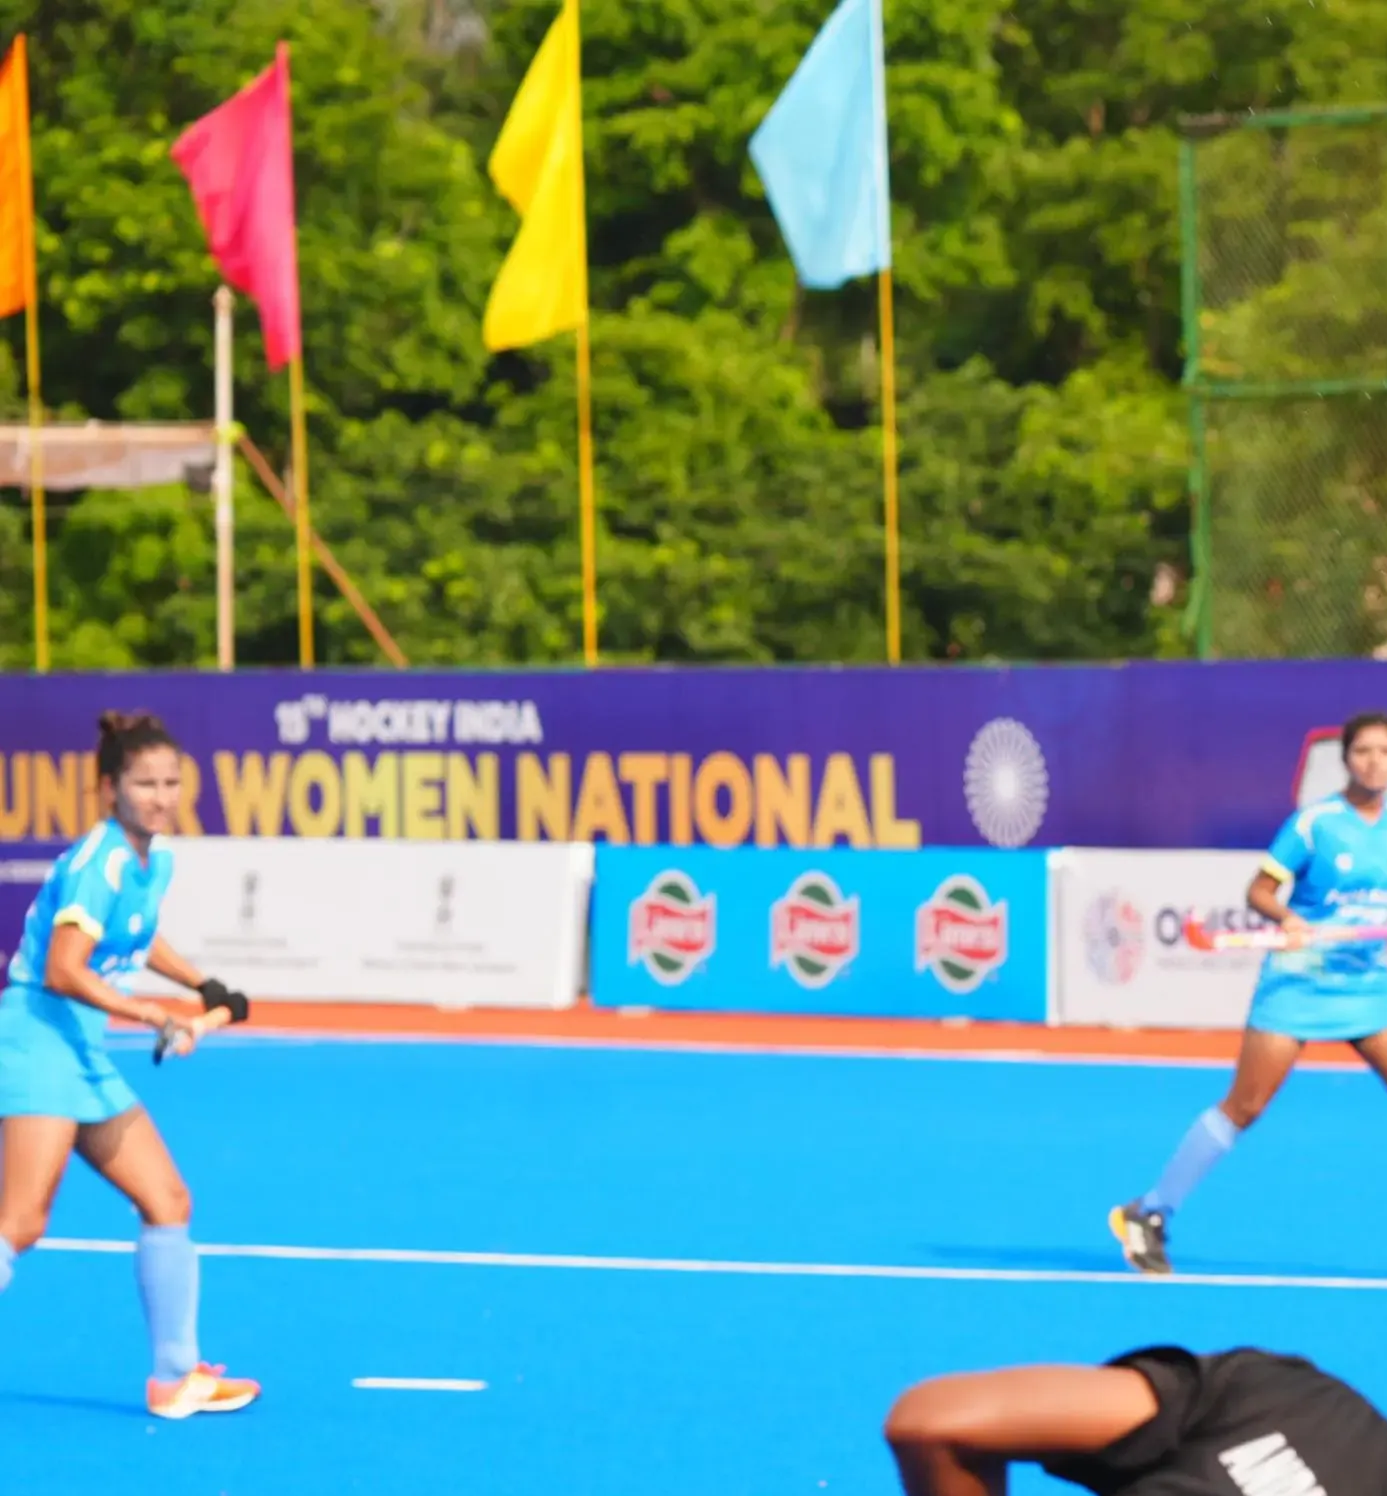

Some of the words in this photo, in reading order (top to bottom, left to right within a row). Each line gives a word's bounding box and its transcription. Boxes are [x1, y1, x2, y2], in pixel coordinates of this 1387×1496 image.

[454, 699, 544, 745] INDIA
[213, 749, 500, 843] WOMEN
[516, 752, 921, 850] NATIONAL
